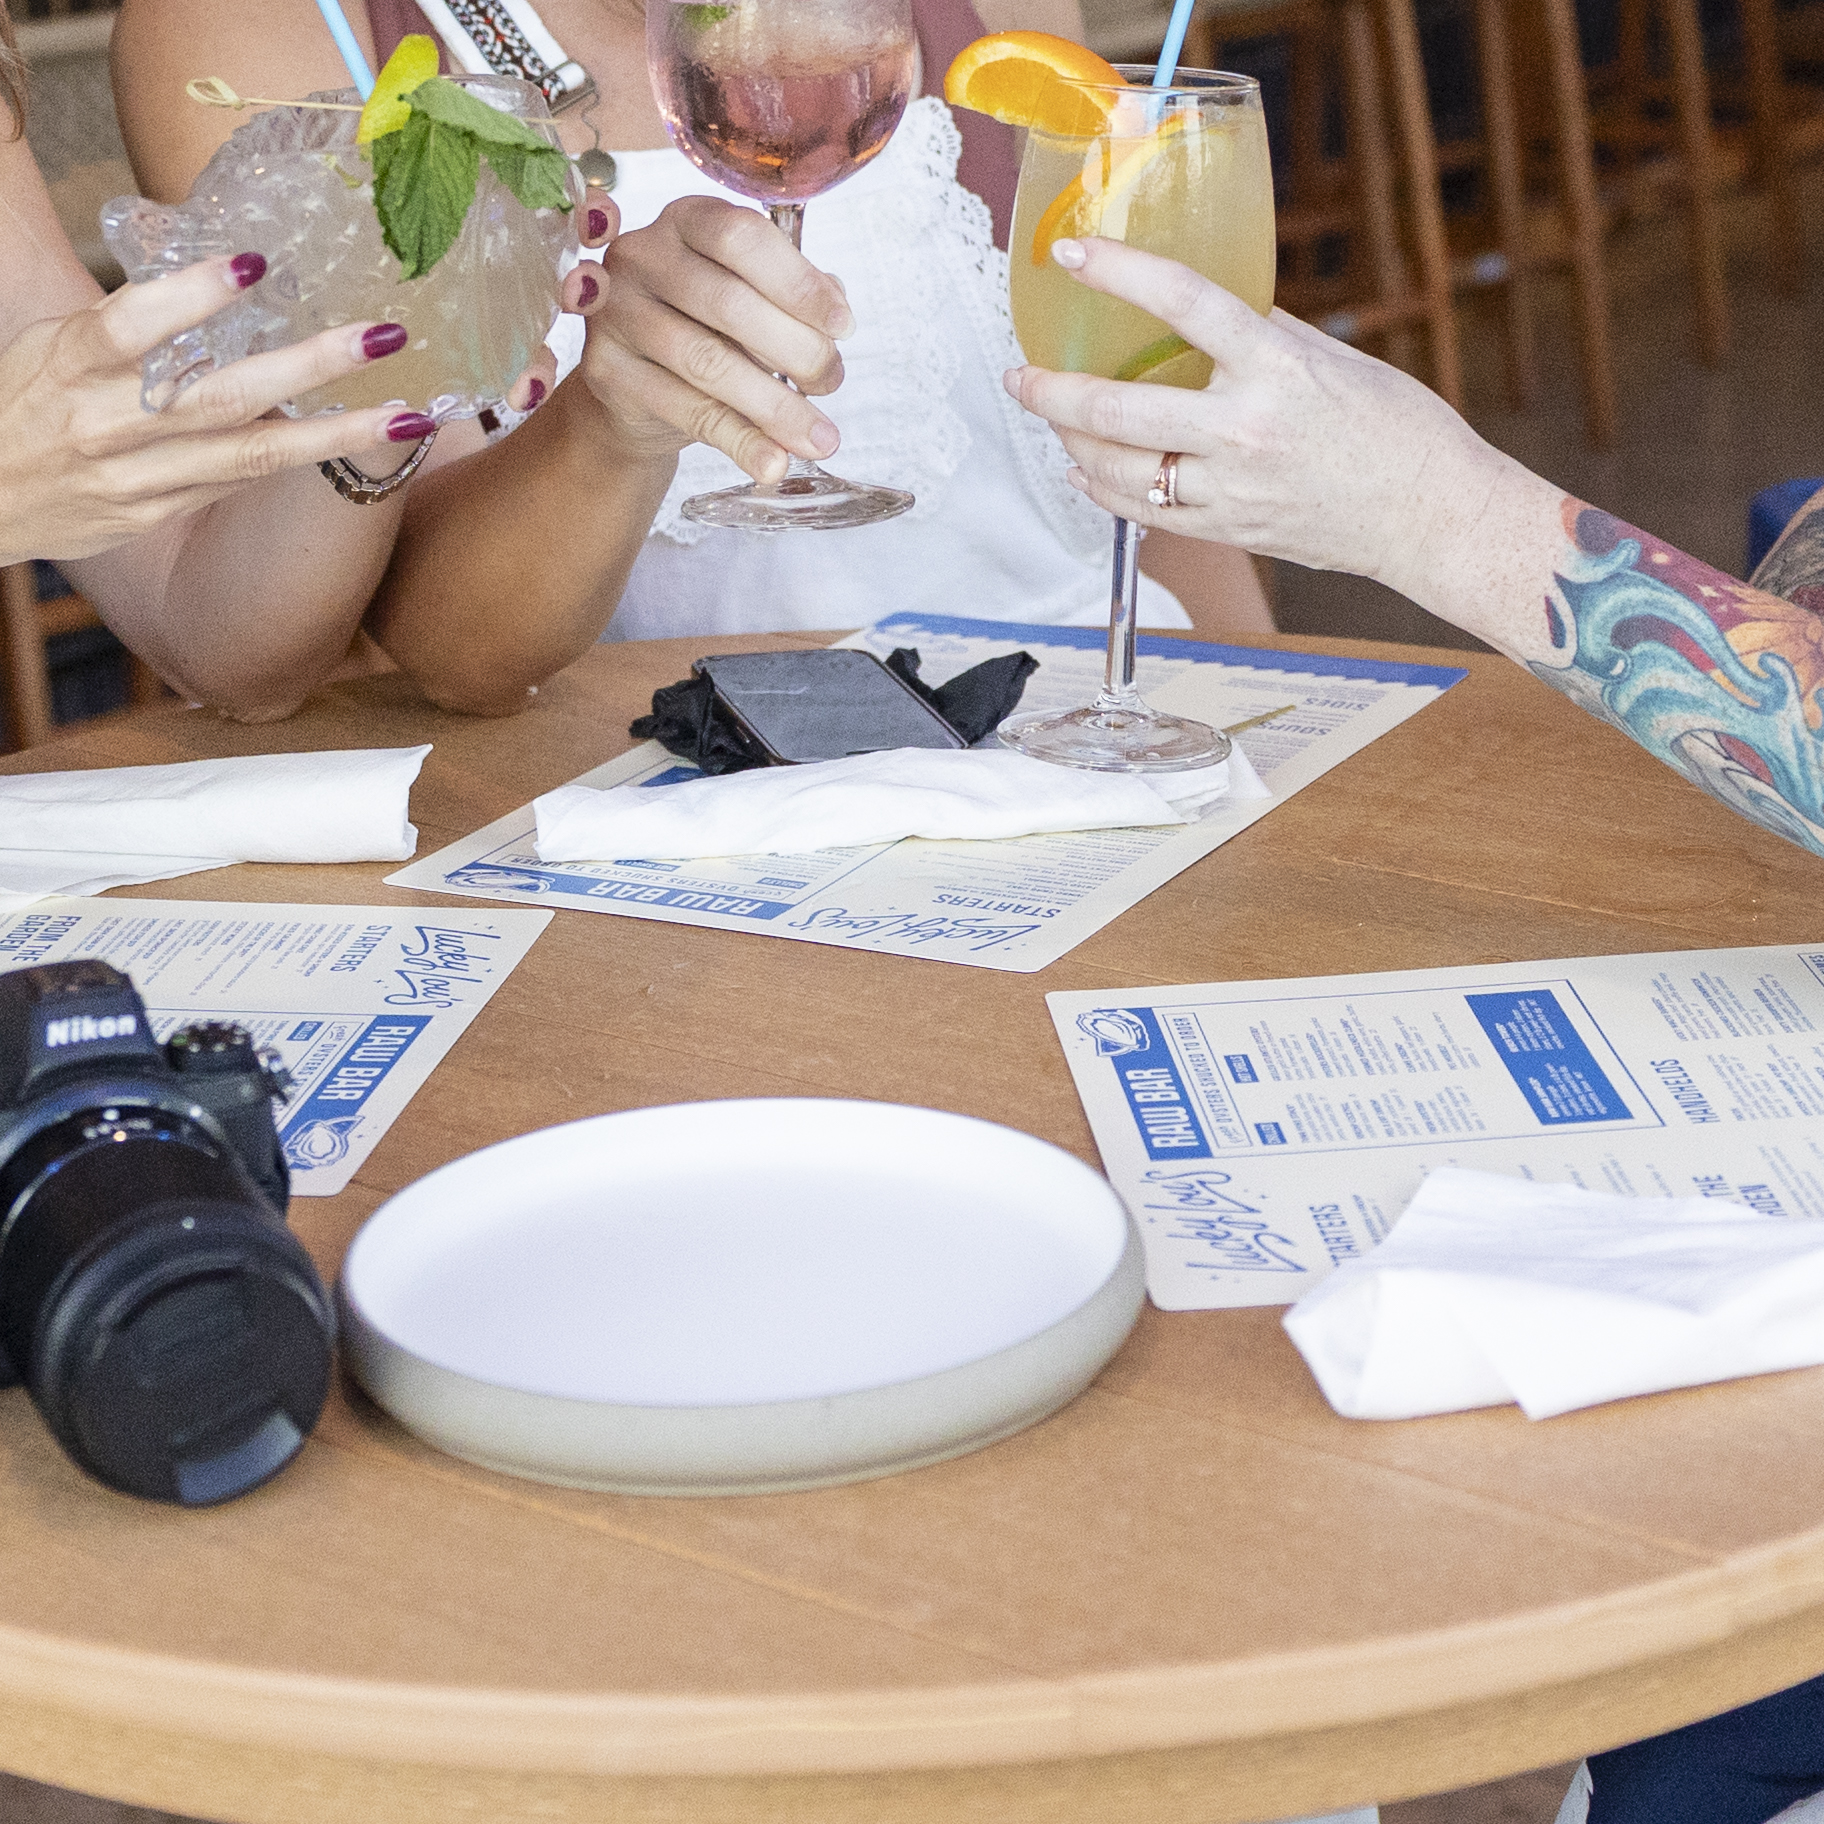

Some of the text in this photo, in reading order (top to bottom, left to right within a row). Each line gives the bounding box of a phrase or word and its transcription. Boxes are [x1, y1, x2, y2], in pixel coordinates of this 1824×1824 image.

[1298, 697, 1371, 710] SIDES
[1252, 721, 1333, 735] SOUPS
[508, 857, 563, 867] ORDER
[588, 867, 664, 881] SHUCKED
[582, 881, 767, 914] RAW BAR
[664, 877, 741, 891] OYSTERS
[927, 893, 1064, 918] STARTERS
[31, 915, 83, 941] FROM
[885, 917, 1041, 950] Lucky
[9, 944, 53, 961] THE
[327, 924, 393, 972] STARTERS
[401, 926, 500, 971] Lucky
[47, 1015, 135, 1048] Nikon
[1172, 1017, 1197, 1039] ORDER
[296, 1043, 337, 1075] OYSTERS
[1182, 1041, 1201, 1050] TO
[314, 1025, 416, 1100] RAW BAR
[1187, 1053, 1217, 1086] SHUCKED
[1123, 1067, 1199, 1148] RAW BAR
[1203, 1088, 1233, 1123] OYSTERS
[1648, 1058, 1722, 1124] HANDHELDS
[1690, 1173, 1734, 1197] THE
[1736, 1184, 1787, 1217] RDEN
[1164, 1215, 1306, 1270] Lucky
[1306, 1204, 1366, 1267] TARTERS
